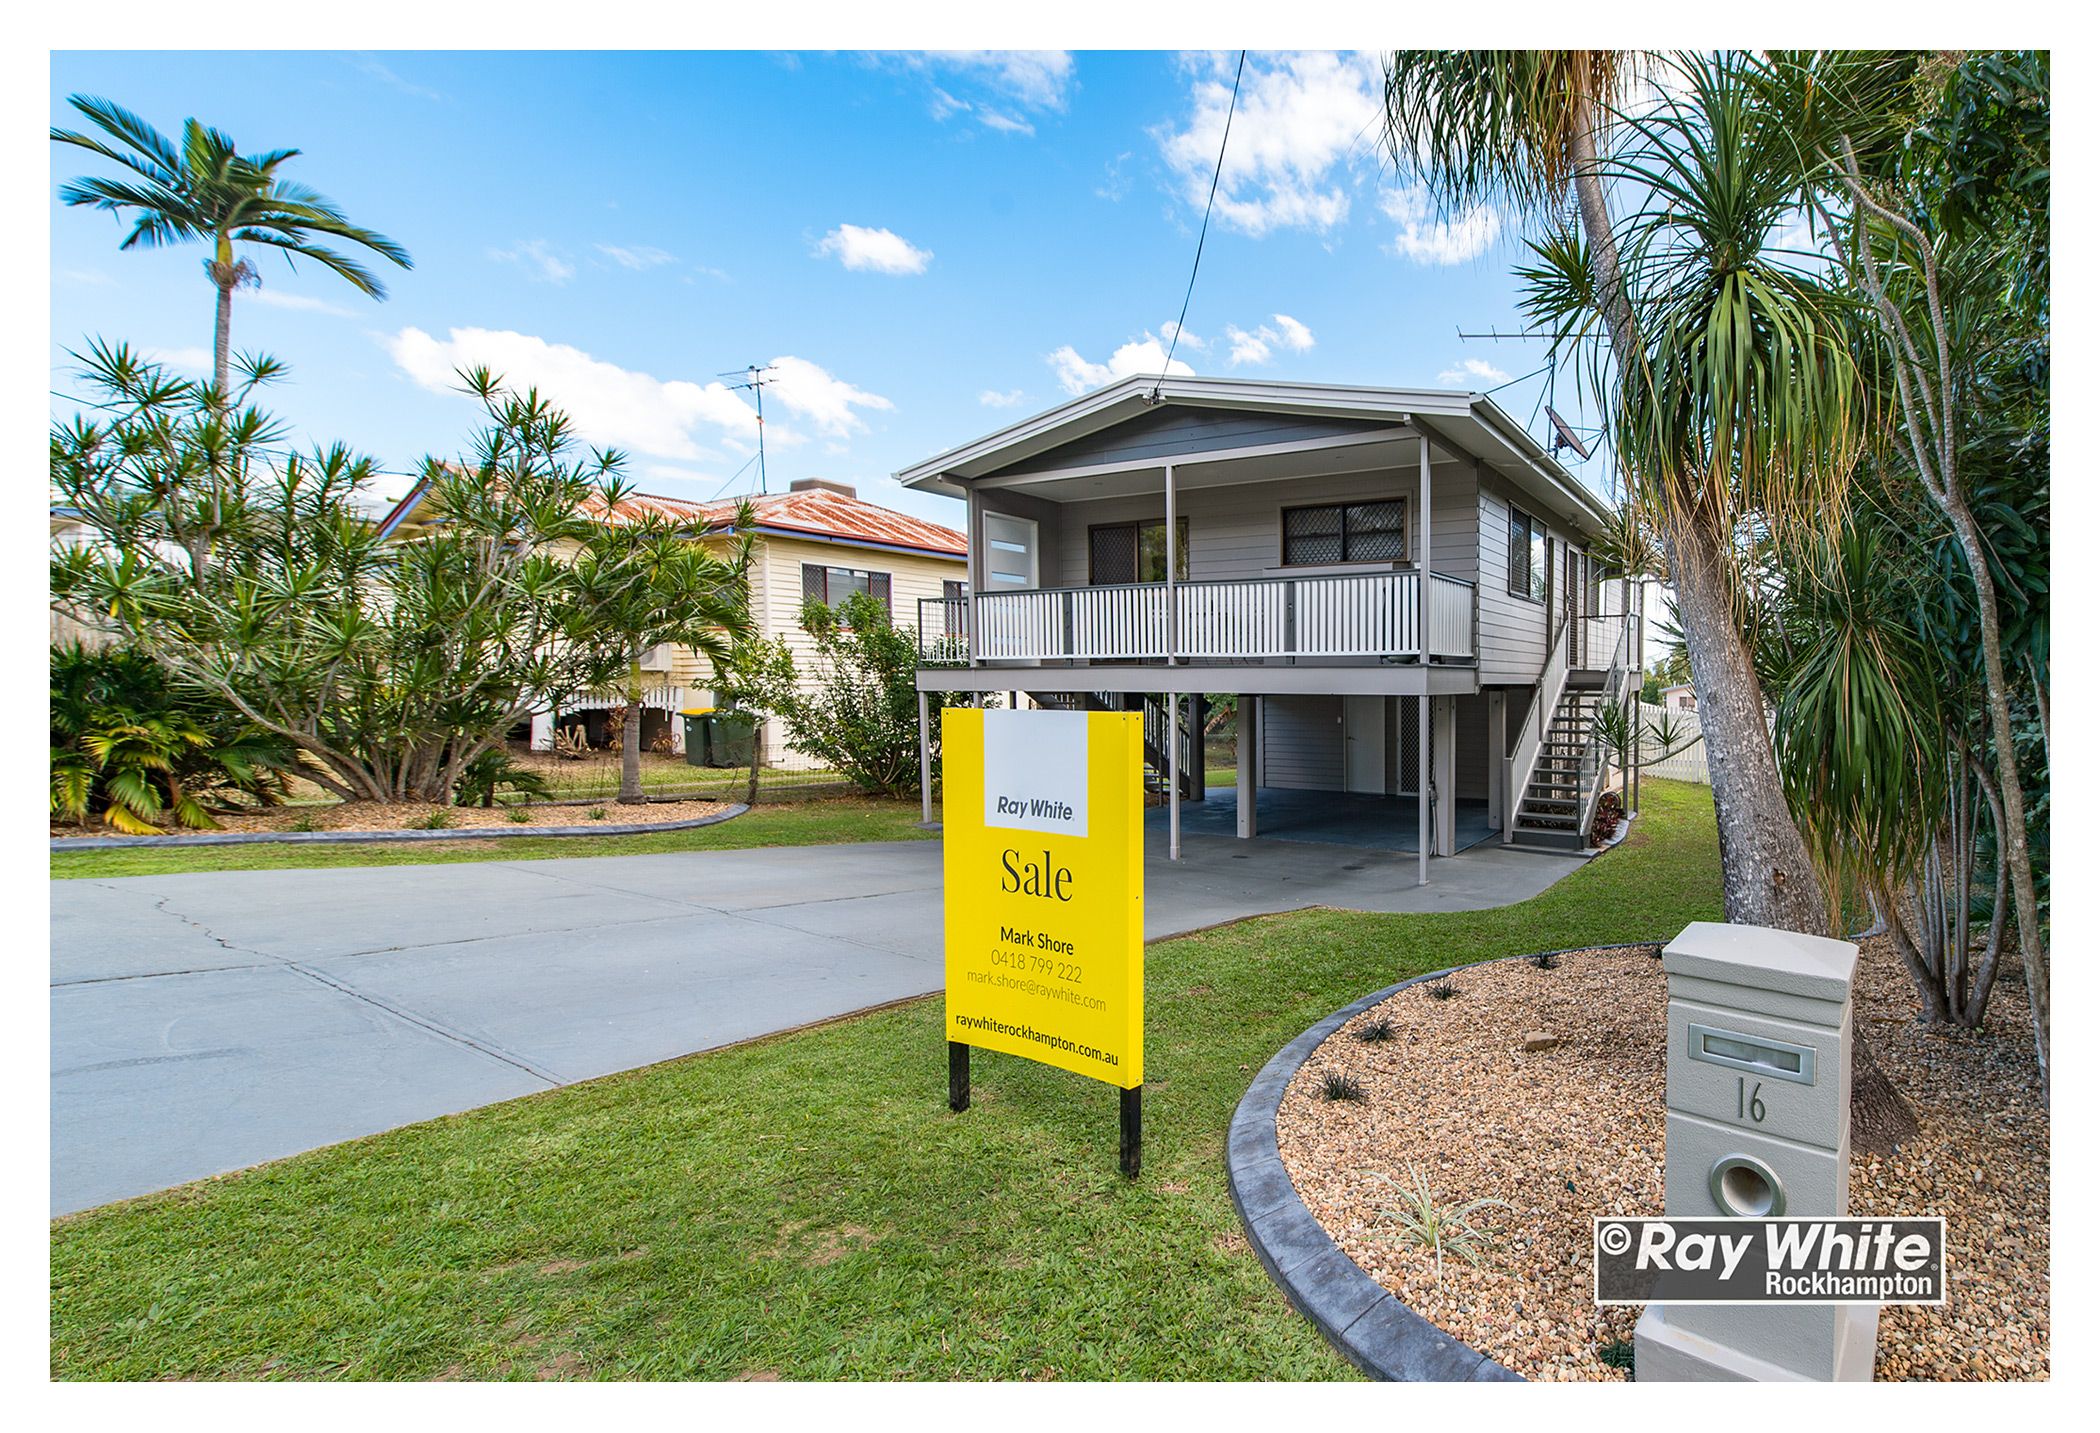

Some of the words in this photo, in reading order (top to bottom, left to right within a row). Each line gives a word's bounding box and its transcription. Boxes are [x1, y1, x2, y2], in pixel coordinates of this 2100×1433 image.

[997, 795, 1028, 819] Ray
[1030, 798, 1073, 821] White
[1001, 848, 1073, 902] Sale
[1000, 926, 1034, 947] Mark
[1037, 932, 1074, 956] Shore
[991, 948, 1026, 971] 0418
[1029, 955, 1054, 976] 799
[1057, 962, 1082, 984] 222
[967, 969, 1106, 1012] mark.shore@raywhite.com
[955, 1012, 1119, 1067] raywhiterockhampton.com.au
[1737, 1076, 1766, 1123] 16
